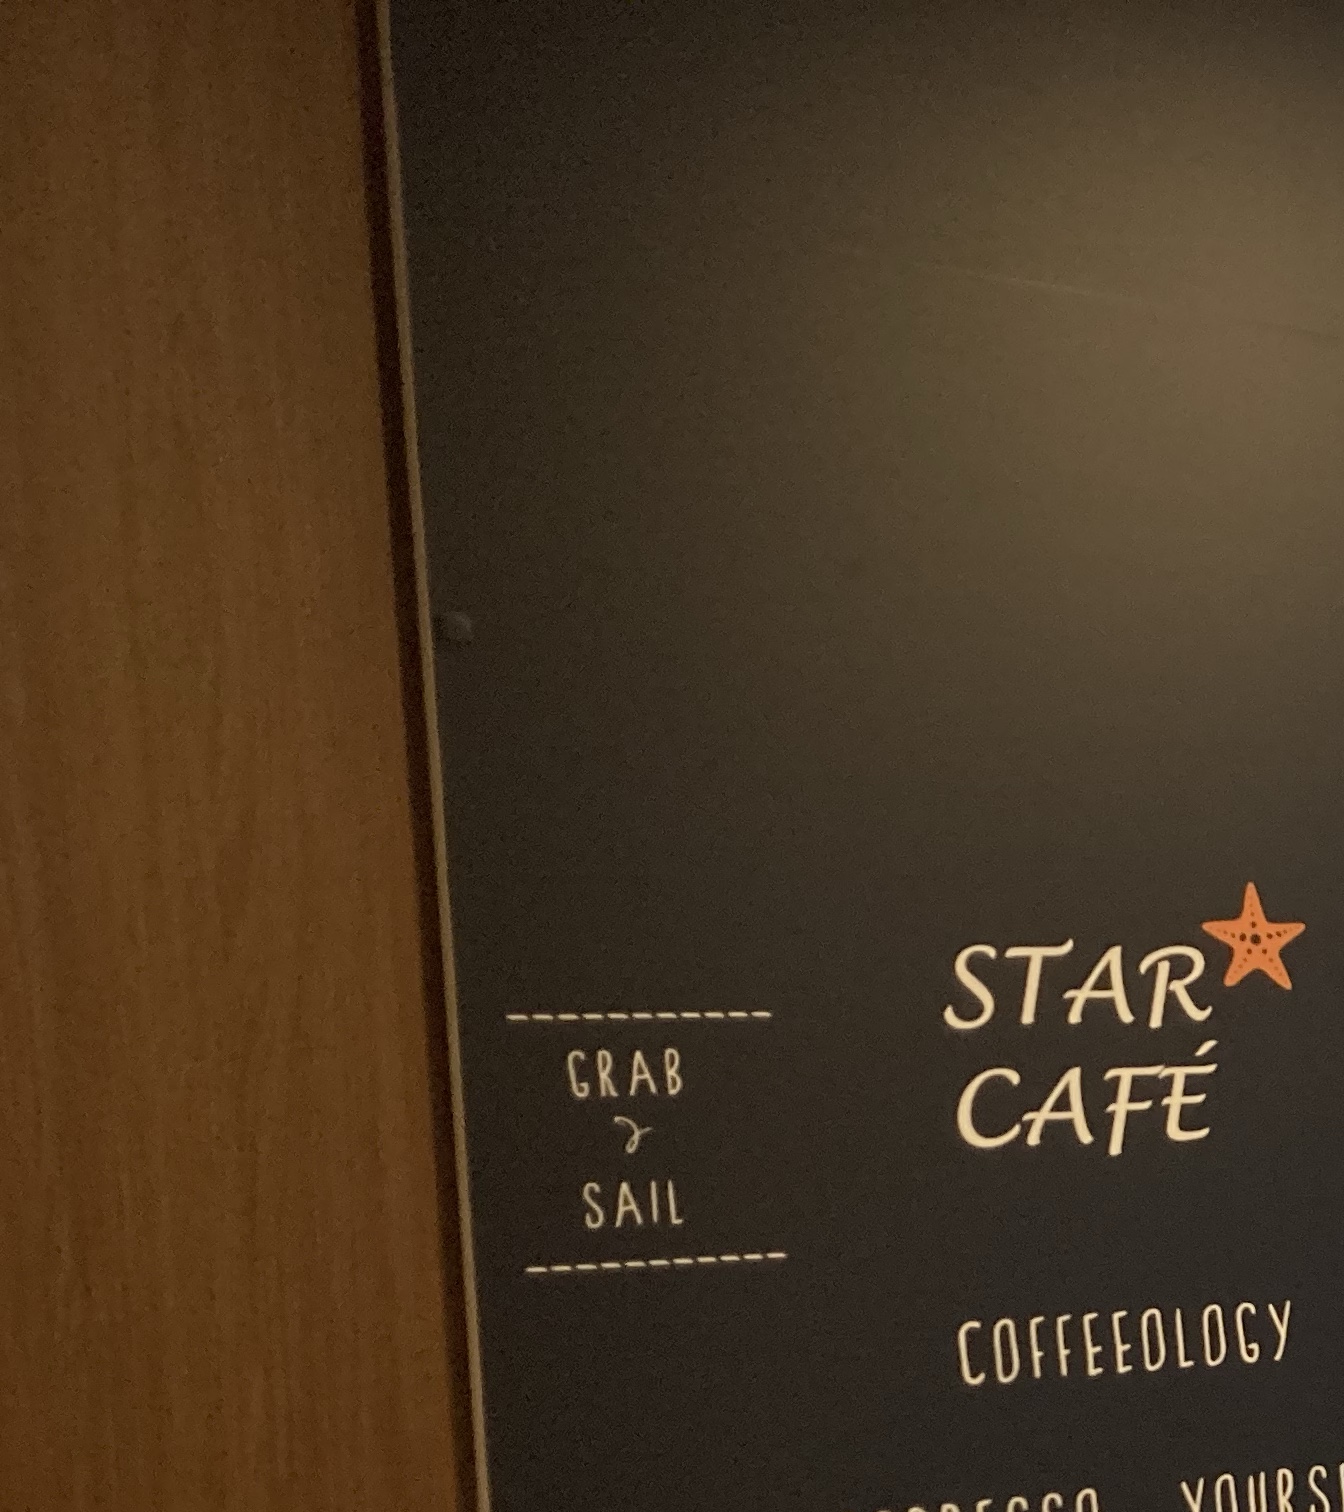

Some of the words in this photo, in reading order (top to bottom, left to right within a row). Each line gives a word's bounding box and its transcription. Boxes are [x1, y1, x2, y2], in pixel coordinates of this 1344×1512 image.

[942, 937, 1214, 1030] STAR
[566, 1046, 684, 1100] GRAB
[956, 1038, 1219, 1158] CAFÉ
[581, 1179, 685, 1230] SAIL
[956, 1299, 1292, 1387] COFFEEOLOGY
